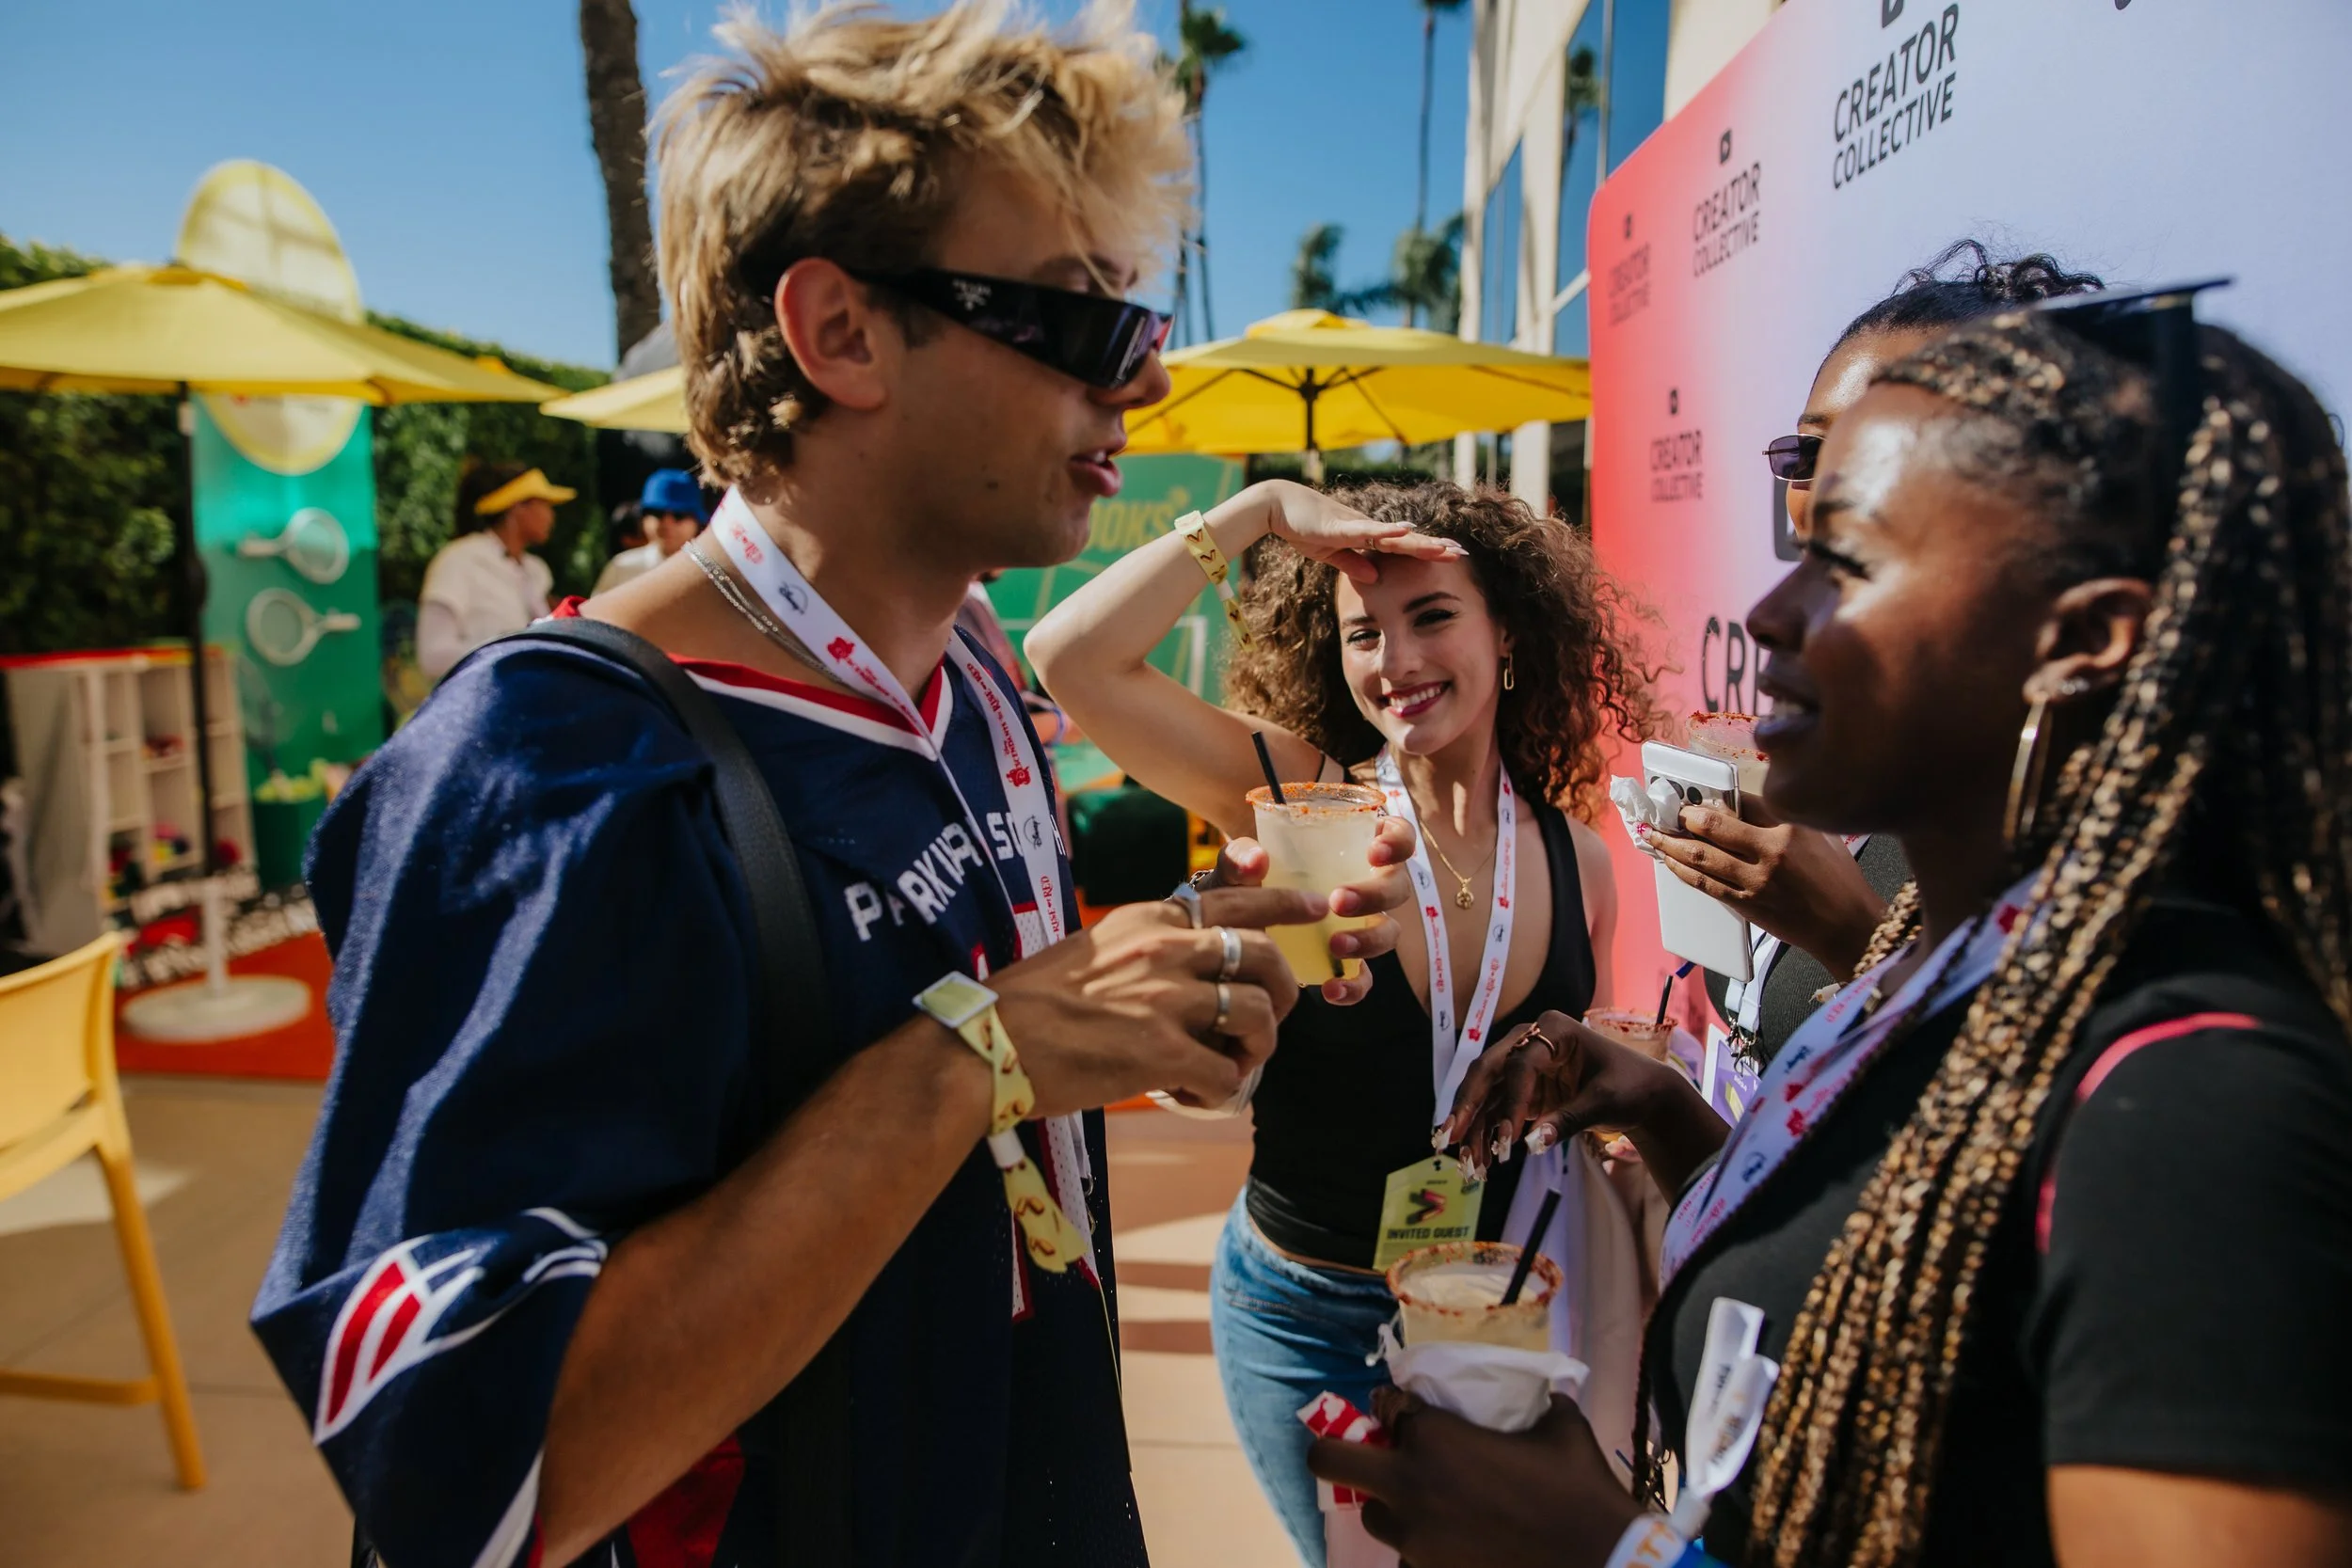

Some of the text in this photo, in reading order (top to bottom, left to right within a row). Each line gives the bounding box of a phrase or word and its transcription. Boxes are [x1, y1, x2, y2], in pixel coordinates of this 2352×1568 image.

[1835, 3, 1959, 143] CREATOR
[1833, 71, 1957, 189] COLLECTIVE
[1693, 161, 1761, 243] CREATOR
[1693, 210, 1760, 277] COLLECTIVE
[966, 663, 982, 682] RED
[984, 689, 1001, 712] RISE
[1040, 875, 1054, 898] RED
[1048, 910, 1059, 932] RISE
[1387, 1226, 1470, 1240] INVITED GUEST
